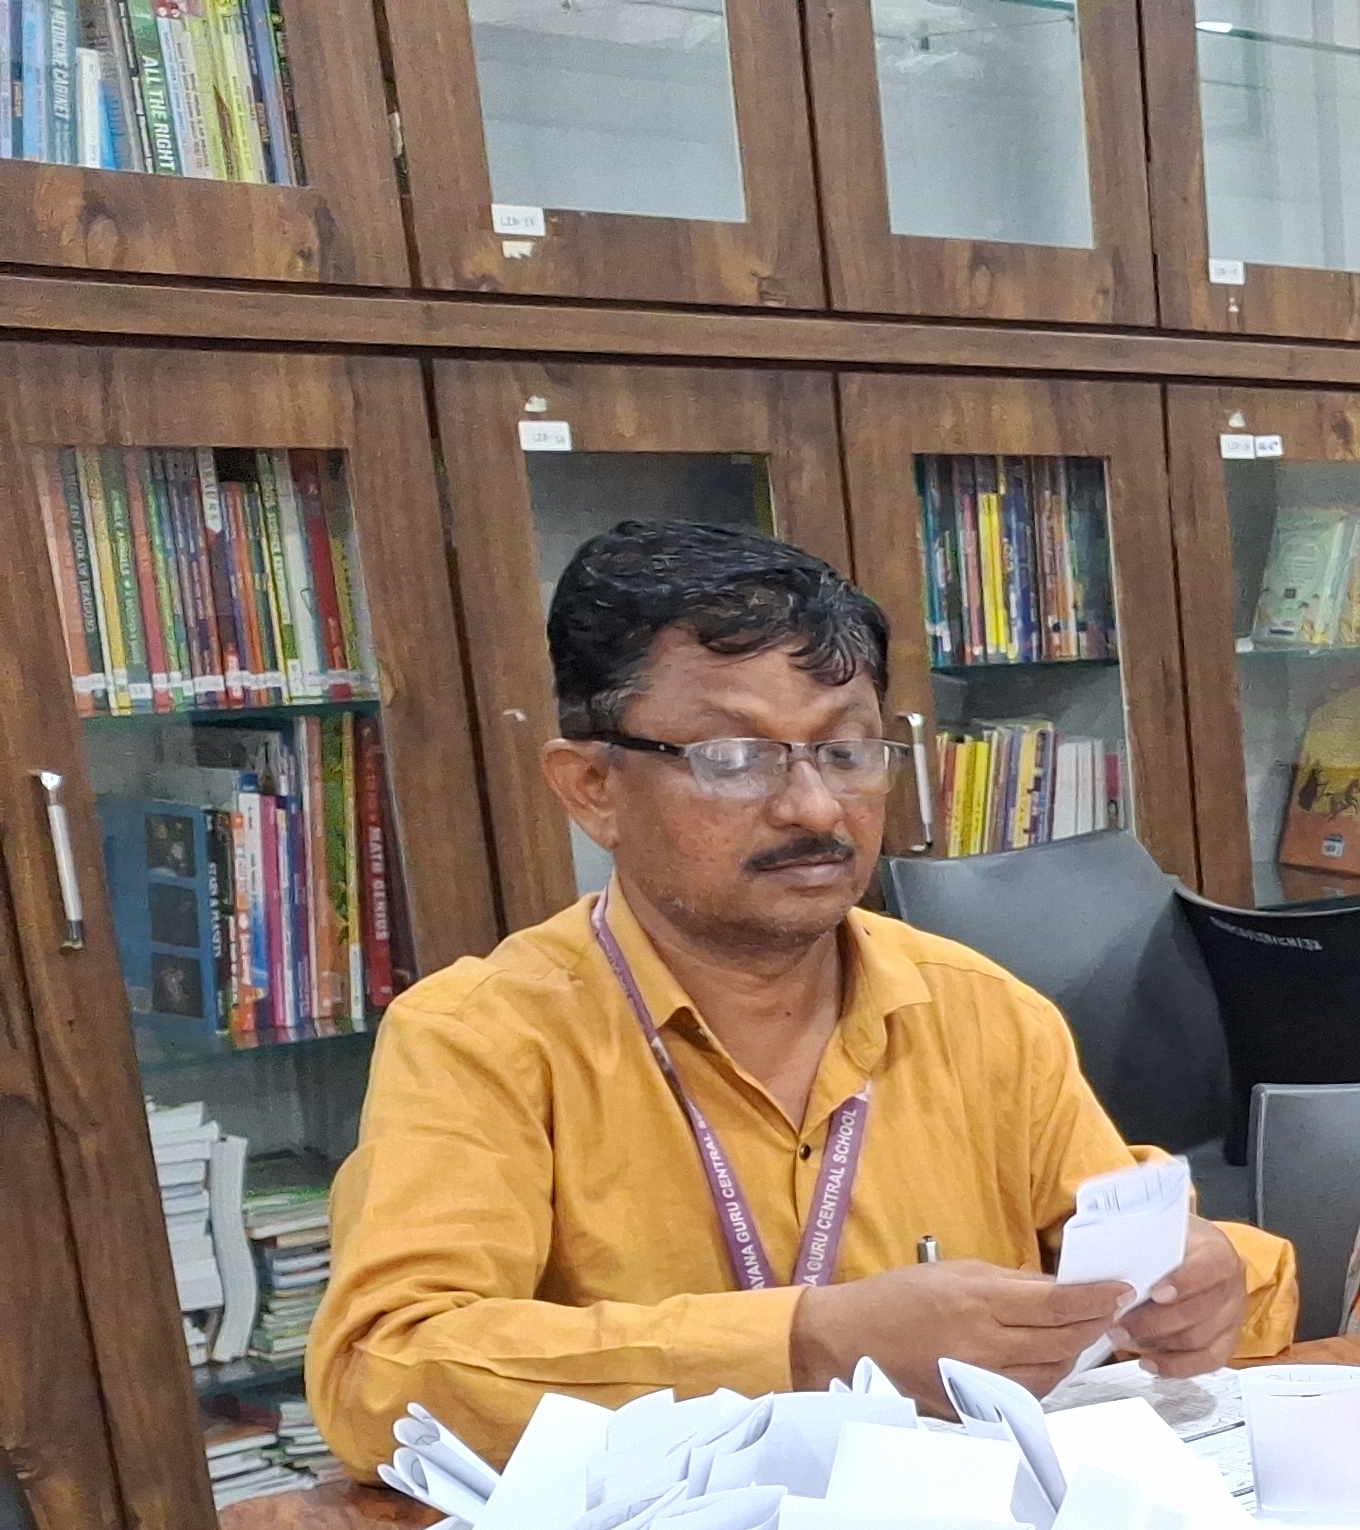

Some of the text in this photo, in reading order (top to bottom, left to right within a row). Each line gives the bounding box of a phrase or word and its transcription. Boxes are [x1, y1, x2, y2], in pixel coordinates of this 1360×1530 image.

[51, 7, 69, 69] MEDICINE
[52, 68, 71, 121] CABINET
[142, 55, 161, 84] ALL
[148, 90, 168, 120] THE
[154, 123, 176, 172] RIGHT
[832, 1108, 858, 1165] SCHOOL
[703, 1134, 736, 1198] CENTRAL
[726, 1202, 751, 1244] GURU
[816, 1167, 845, 1230] CENTRAL
[806, 1231, 828, 1272] GURU
